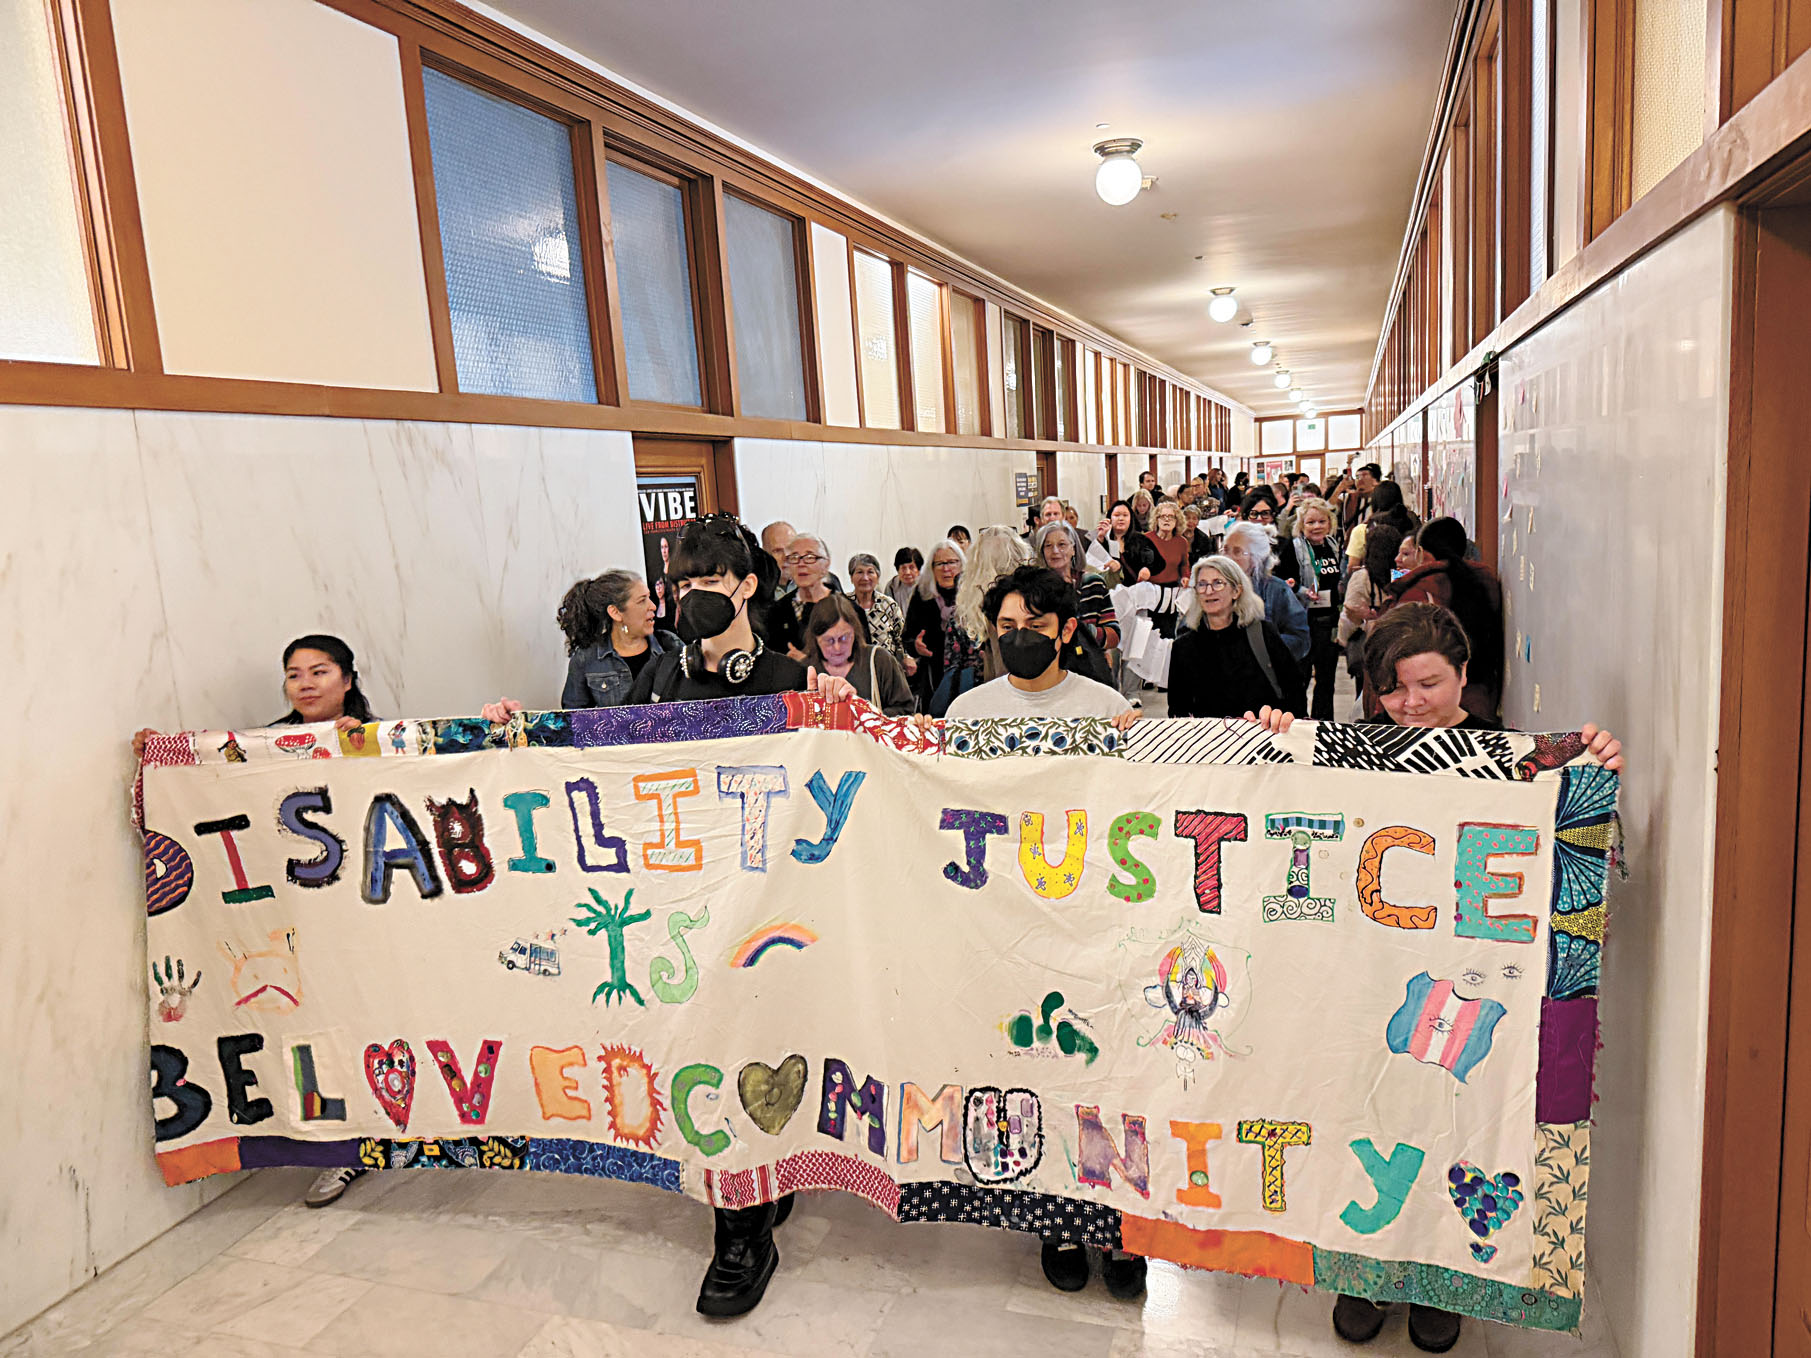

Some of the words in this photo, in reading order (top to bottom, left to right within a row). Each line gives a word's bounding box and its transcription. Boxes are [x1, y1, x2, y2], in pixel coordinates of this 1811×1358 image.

[639, 491, 696, 522] VIBE
[144, 766, 865, 917] DISABILITY
[940, 809, 1541, 943] JUSTICE
